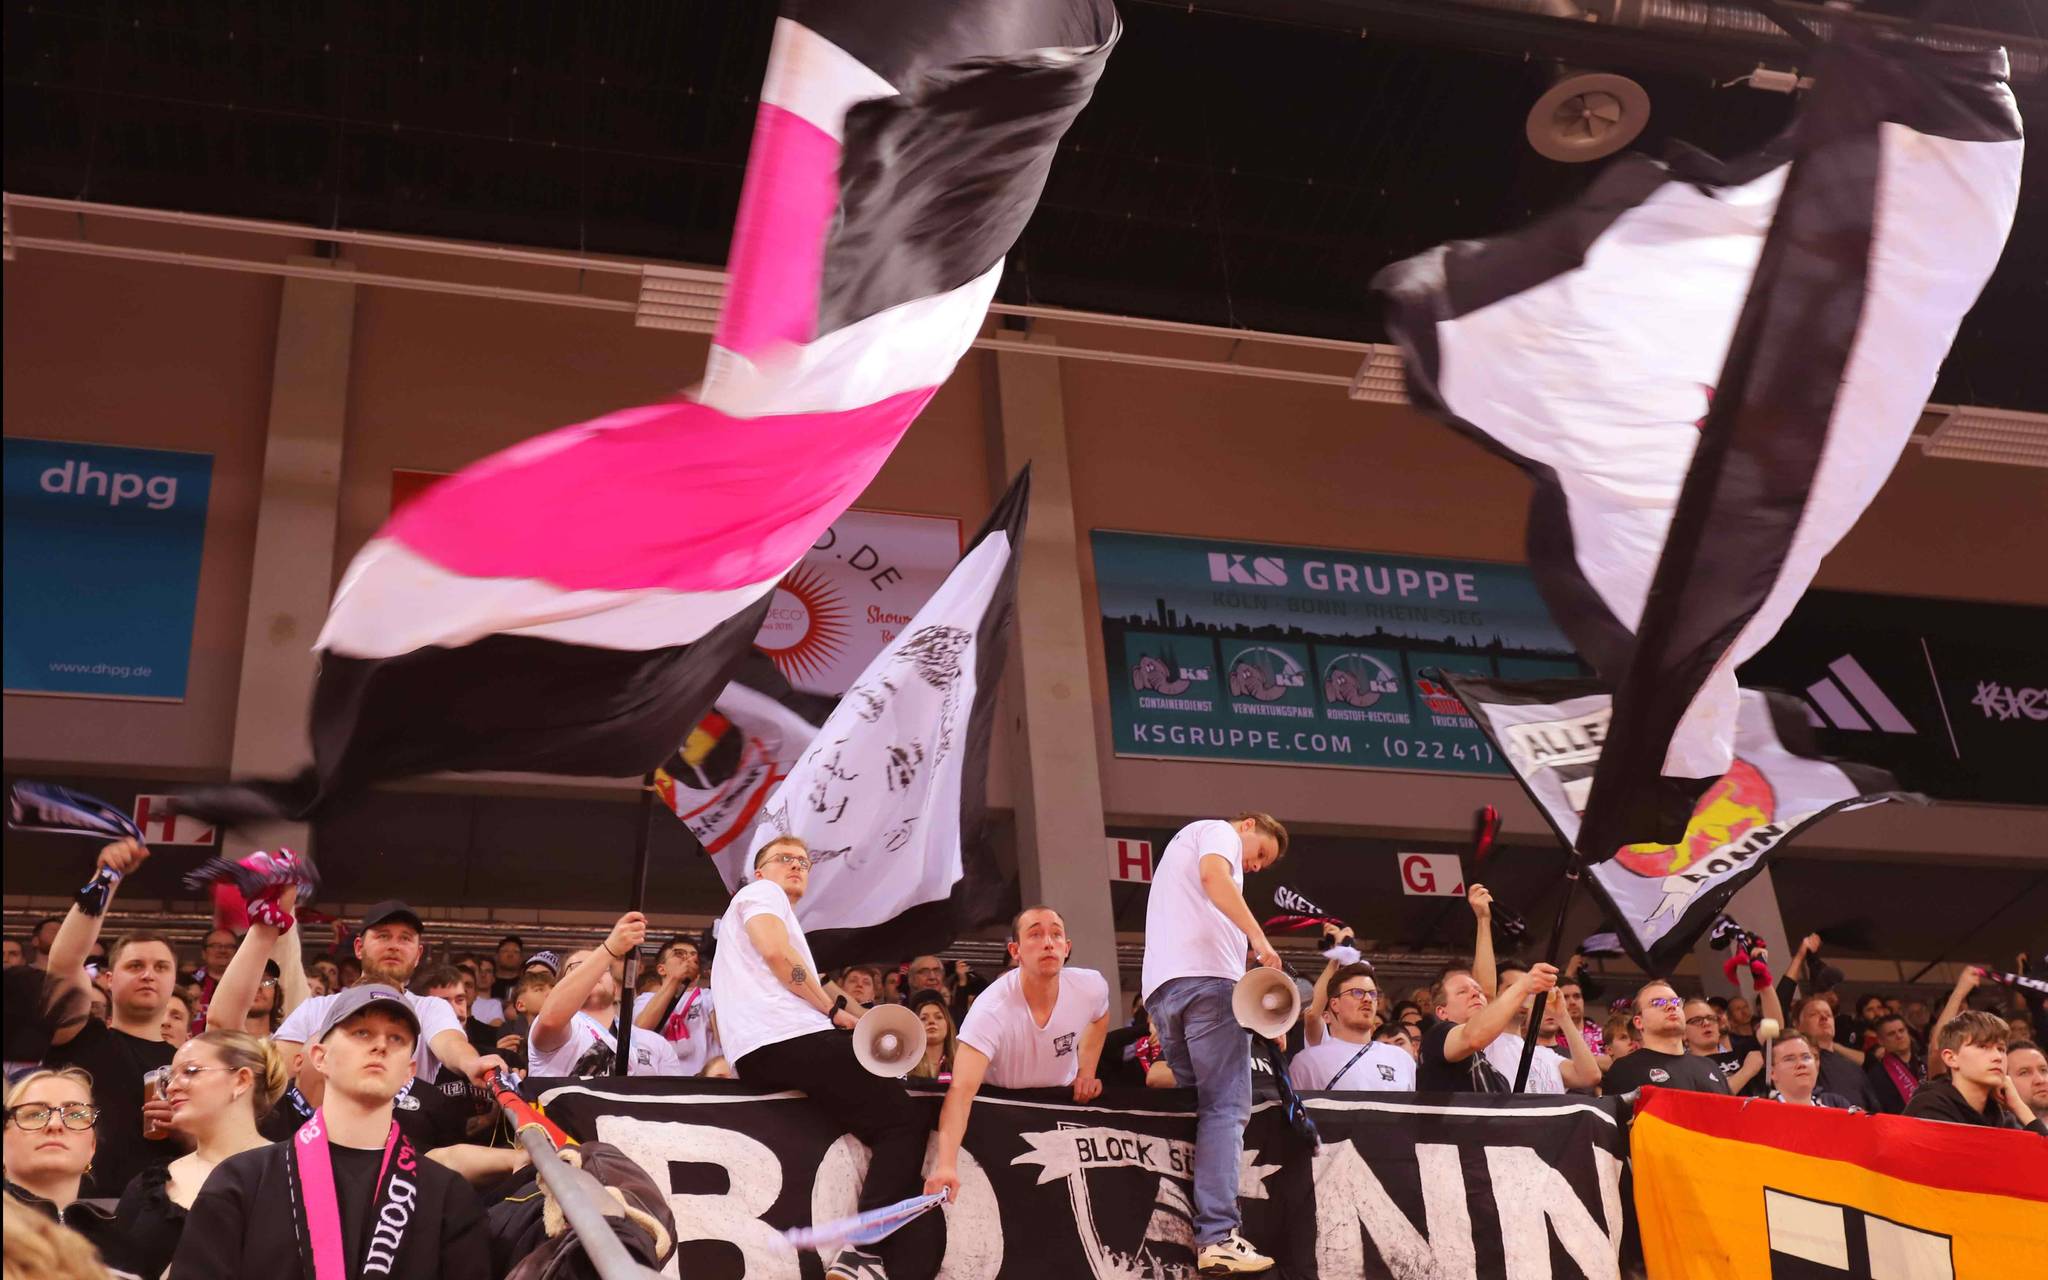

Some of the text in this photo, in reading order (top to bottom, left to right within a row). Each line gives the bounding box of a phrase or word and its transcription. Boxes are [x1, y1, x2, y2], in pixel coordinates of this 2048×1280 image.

[40, 460, 178, 510] dhpg
[1208, 552, 1479, 602] KS GRUPPE
[1287, 596, 1347, 616] BONN
[1363, 603, 1484, 627] RHEIN-SIEG
[49, 661, 152, 678] www.dhpg.de
[1179, 667, 1209, 681] KS
[1276, 674, 1304, 687] KS
[1369, 680, 1398, 693] KS
[1138, 696, 1213, 713] CONTAINERDIENST
[1232, 703, 1314, 718] VERWERTUNGSPARK
[1326, 708, 1410, 725] ROHSTOFF-RECYCLING
[1431, 715, 1458, 728] TRUCK
[1133, 723, 1352, 753] KSGRUPPE.COM
[1526, 722, 1604, 760] ALLE
[136, 797, 176, 843] H
[1117, 841, 1152, 882] H
[1403, 854, 1436, 894] G
[1076, 1136, 1156, 1167] BLOCK
[363, 1173, 417, 1275] Bonn
